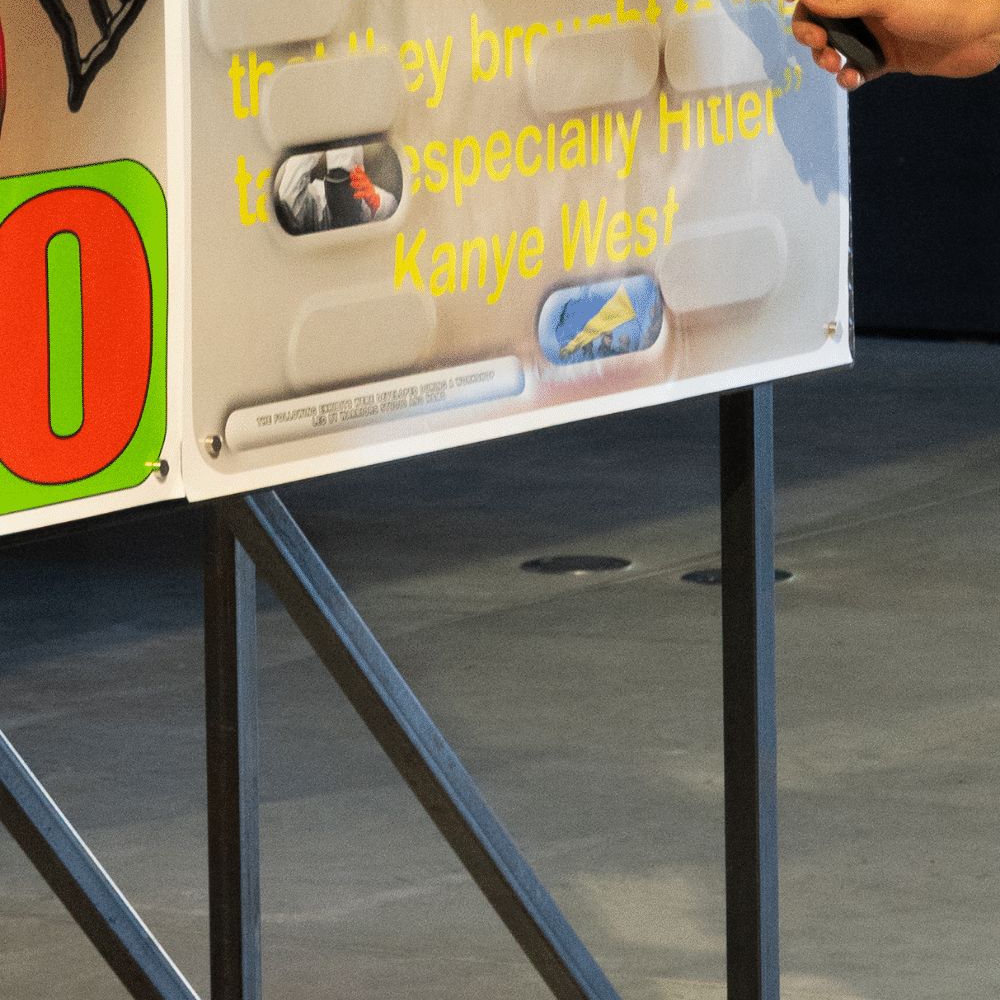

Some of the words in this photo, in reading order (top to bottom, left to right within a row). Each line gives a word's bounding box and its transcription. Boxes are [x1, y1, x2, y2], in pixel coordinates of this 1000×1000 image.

[349, 28, 455, 109] ey
[393, 228, 546, 304] Kanye
[560, 186, 680, 272] West
